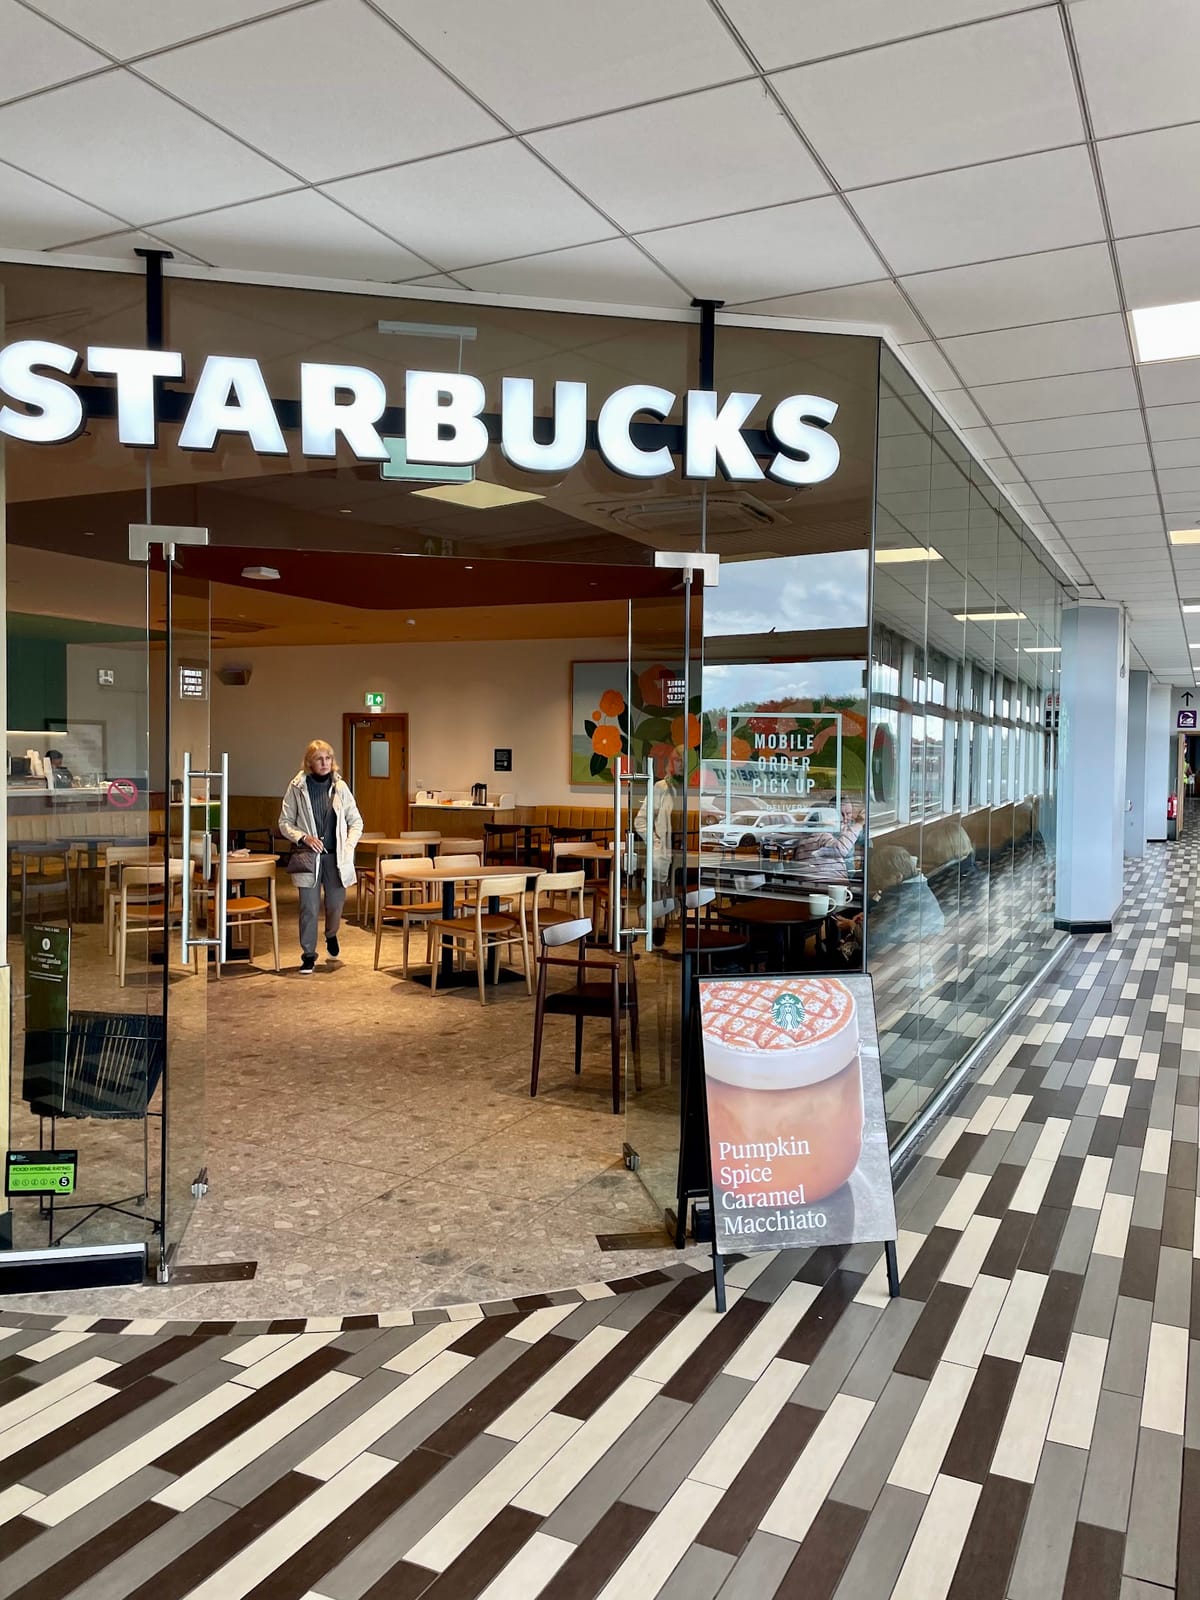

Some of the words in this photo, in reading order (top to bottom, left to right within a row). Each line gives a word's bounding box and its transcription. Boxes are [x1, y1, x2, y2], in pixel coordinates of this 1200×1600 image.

[0, 339, 841, 486] STARBUCKS
[754, 732, 815, 750] MOBILE
[758, 755, 811, 772] ORDER
[752, 778, 790, 794] PICK
[795, 779, 816, 794] UP
[718, 1136, 811, 1162] Pumpkin
[60, 1178, 68, 1186] 5
[720, 1164, 773, 1189] Spice
[722, 1184, 807, 1210] Caramel
[723, 1209, 827, 1236] Macchiato
